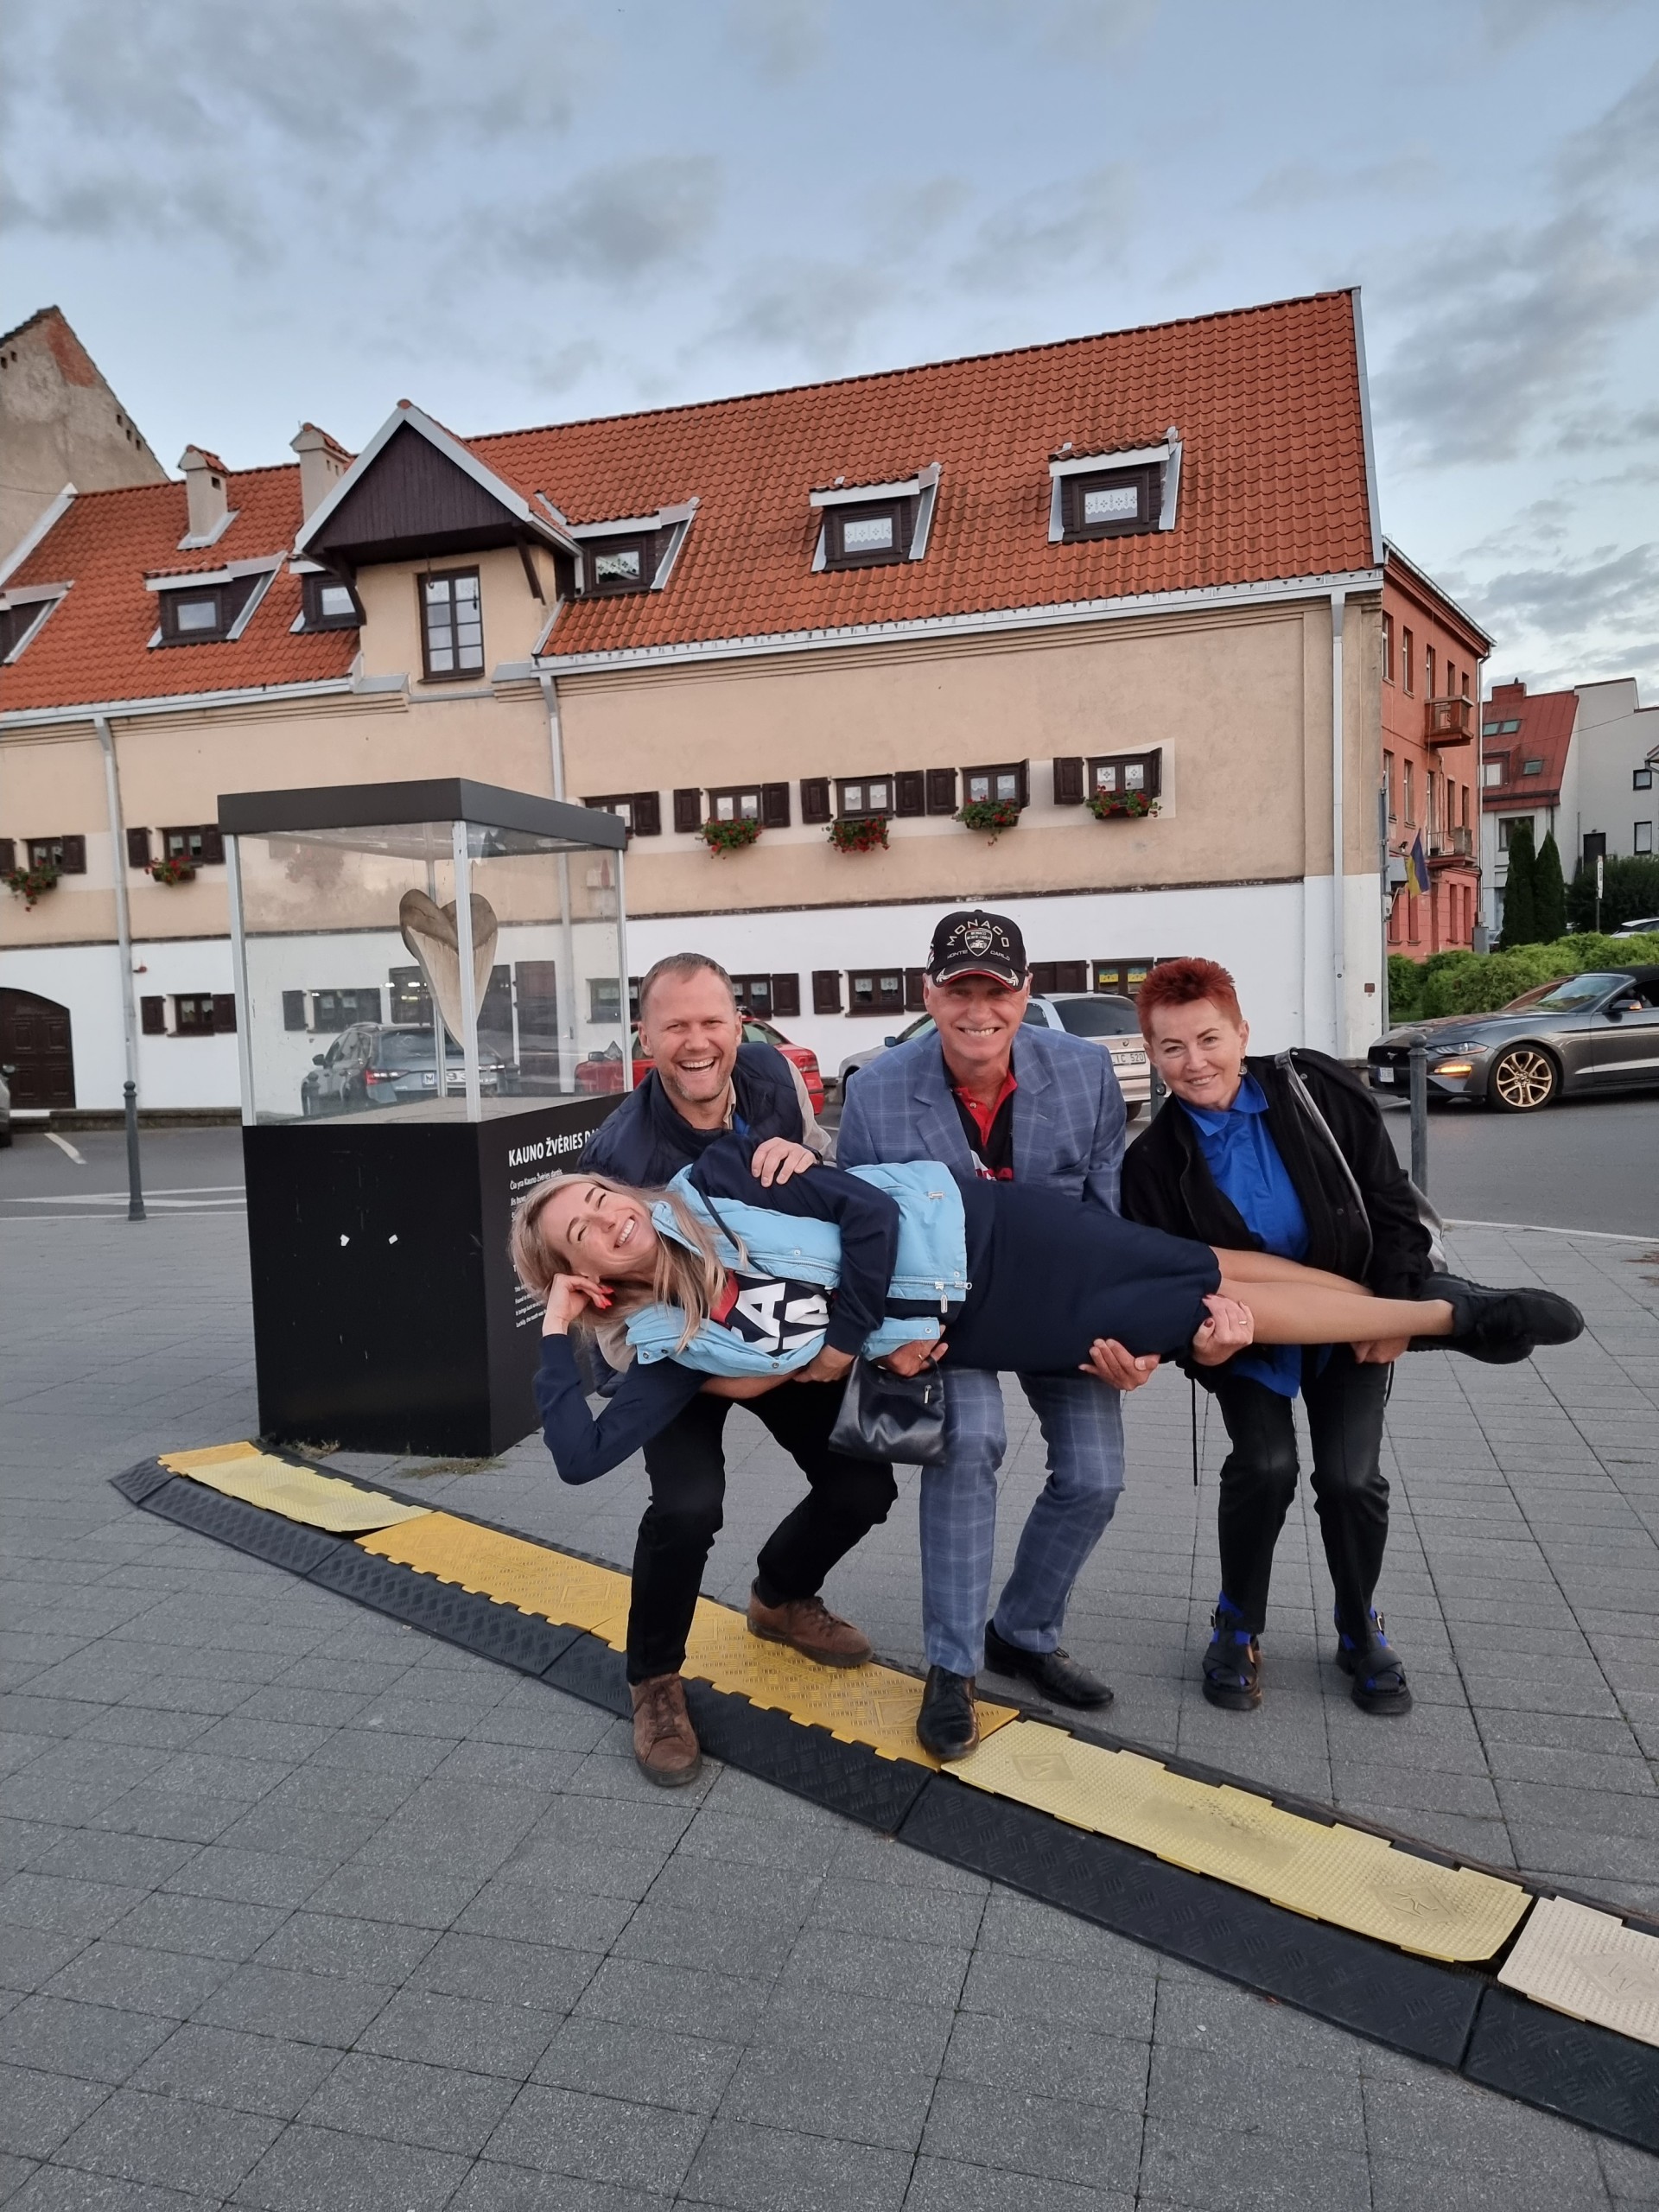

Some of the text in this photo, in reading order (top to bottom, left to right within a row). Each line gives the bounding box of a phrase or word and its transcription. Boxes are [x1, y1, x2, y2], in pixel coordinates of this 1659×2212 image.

[947, 919, 1010, 948] MONACO
[947, 950, 1011, 962] MONTE CARLO
[1112, 1052, 1144, 1064] IC 520
[508, 1142, 544, 1167] KAUNO
[545, 1132, 583, 1157] ŽVĖRIES
